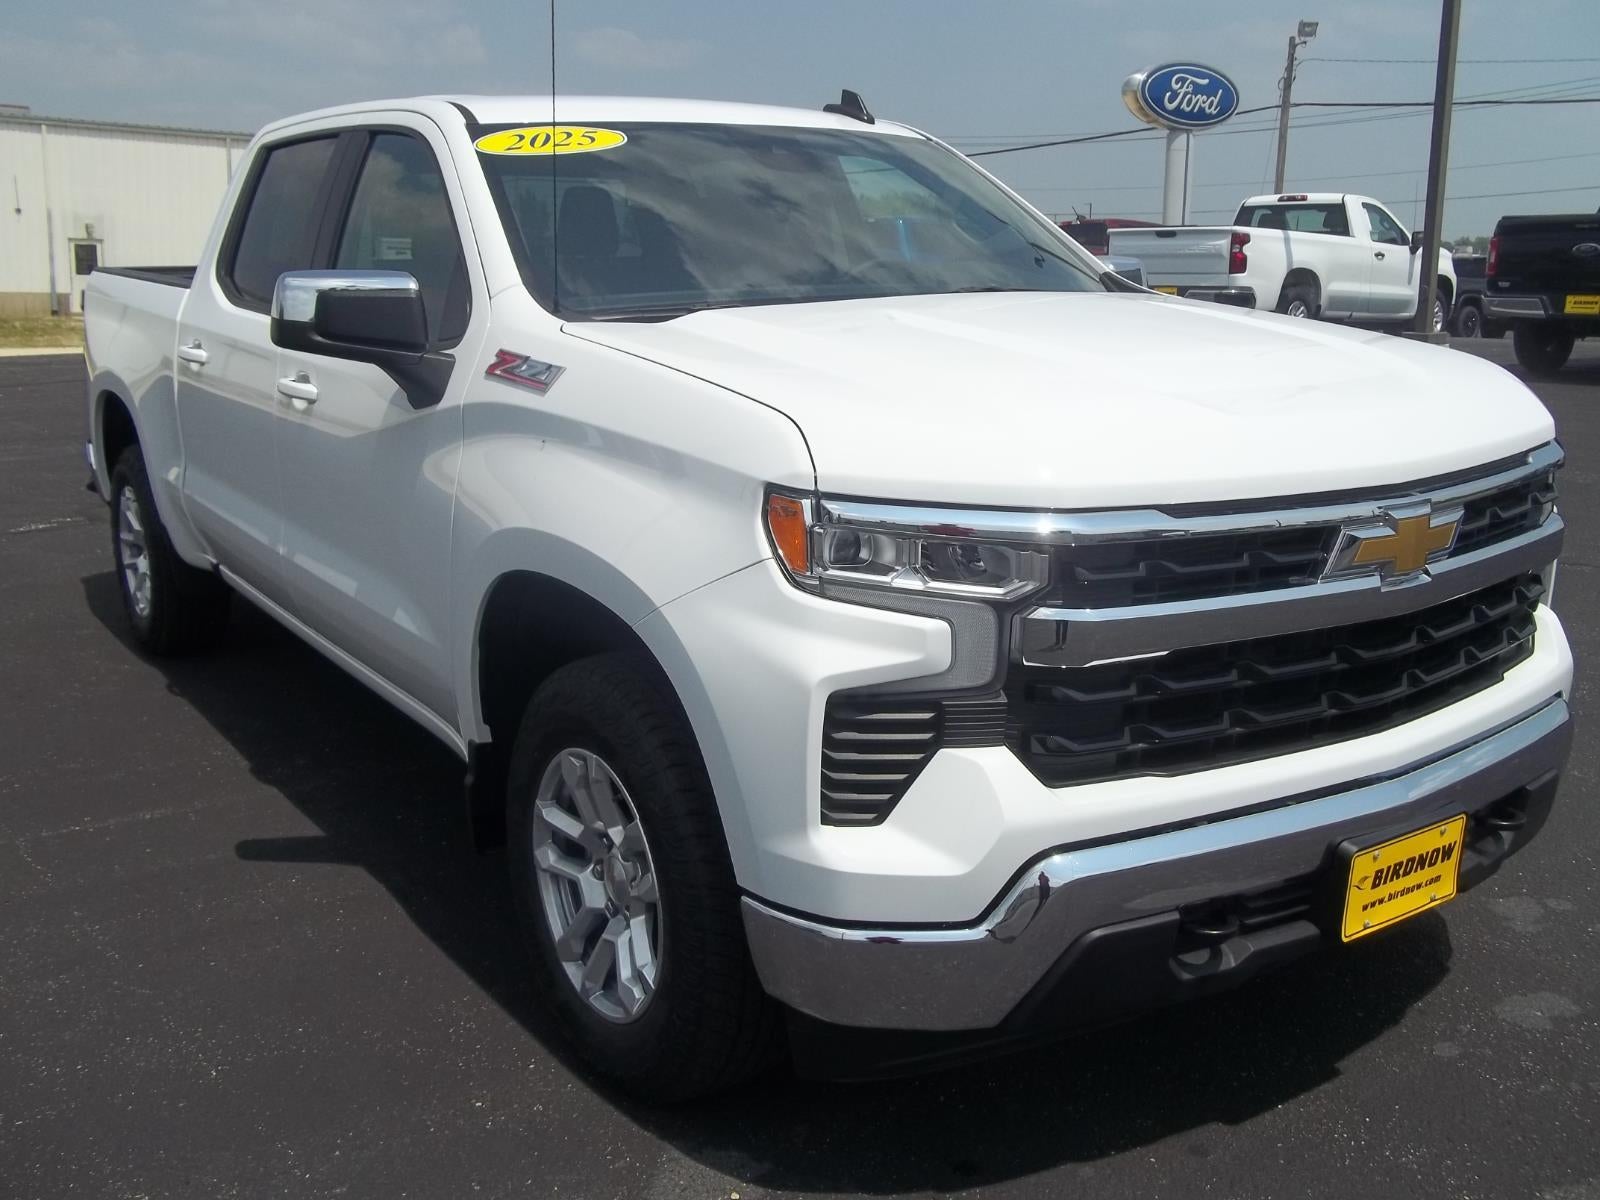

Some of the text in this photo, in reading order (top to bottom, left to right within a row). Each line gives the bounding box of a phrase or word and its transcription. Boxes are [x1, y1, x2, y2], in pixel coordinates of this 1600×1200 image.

[1164, 73, 1222, 115] Ford
[504, 130, 598, 151] 2025
[1370, 840, 1457, 890] BIRDNOW
[1361, 874, 1442, 912] www.birdnow.com
